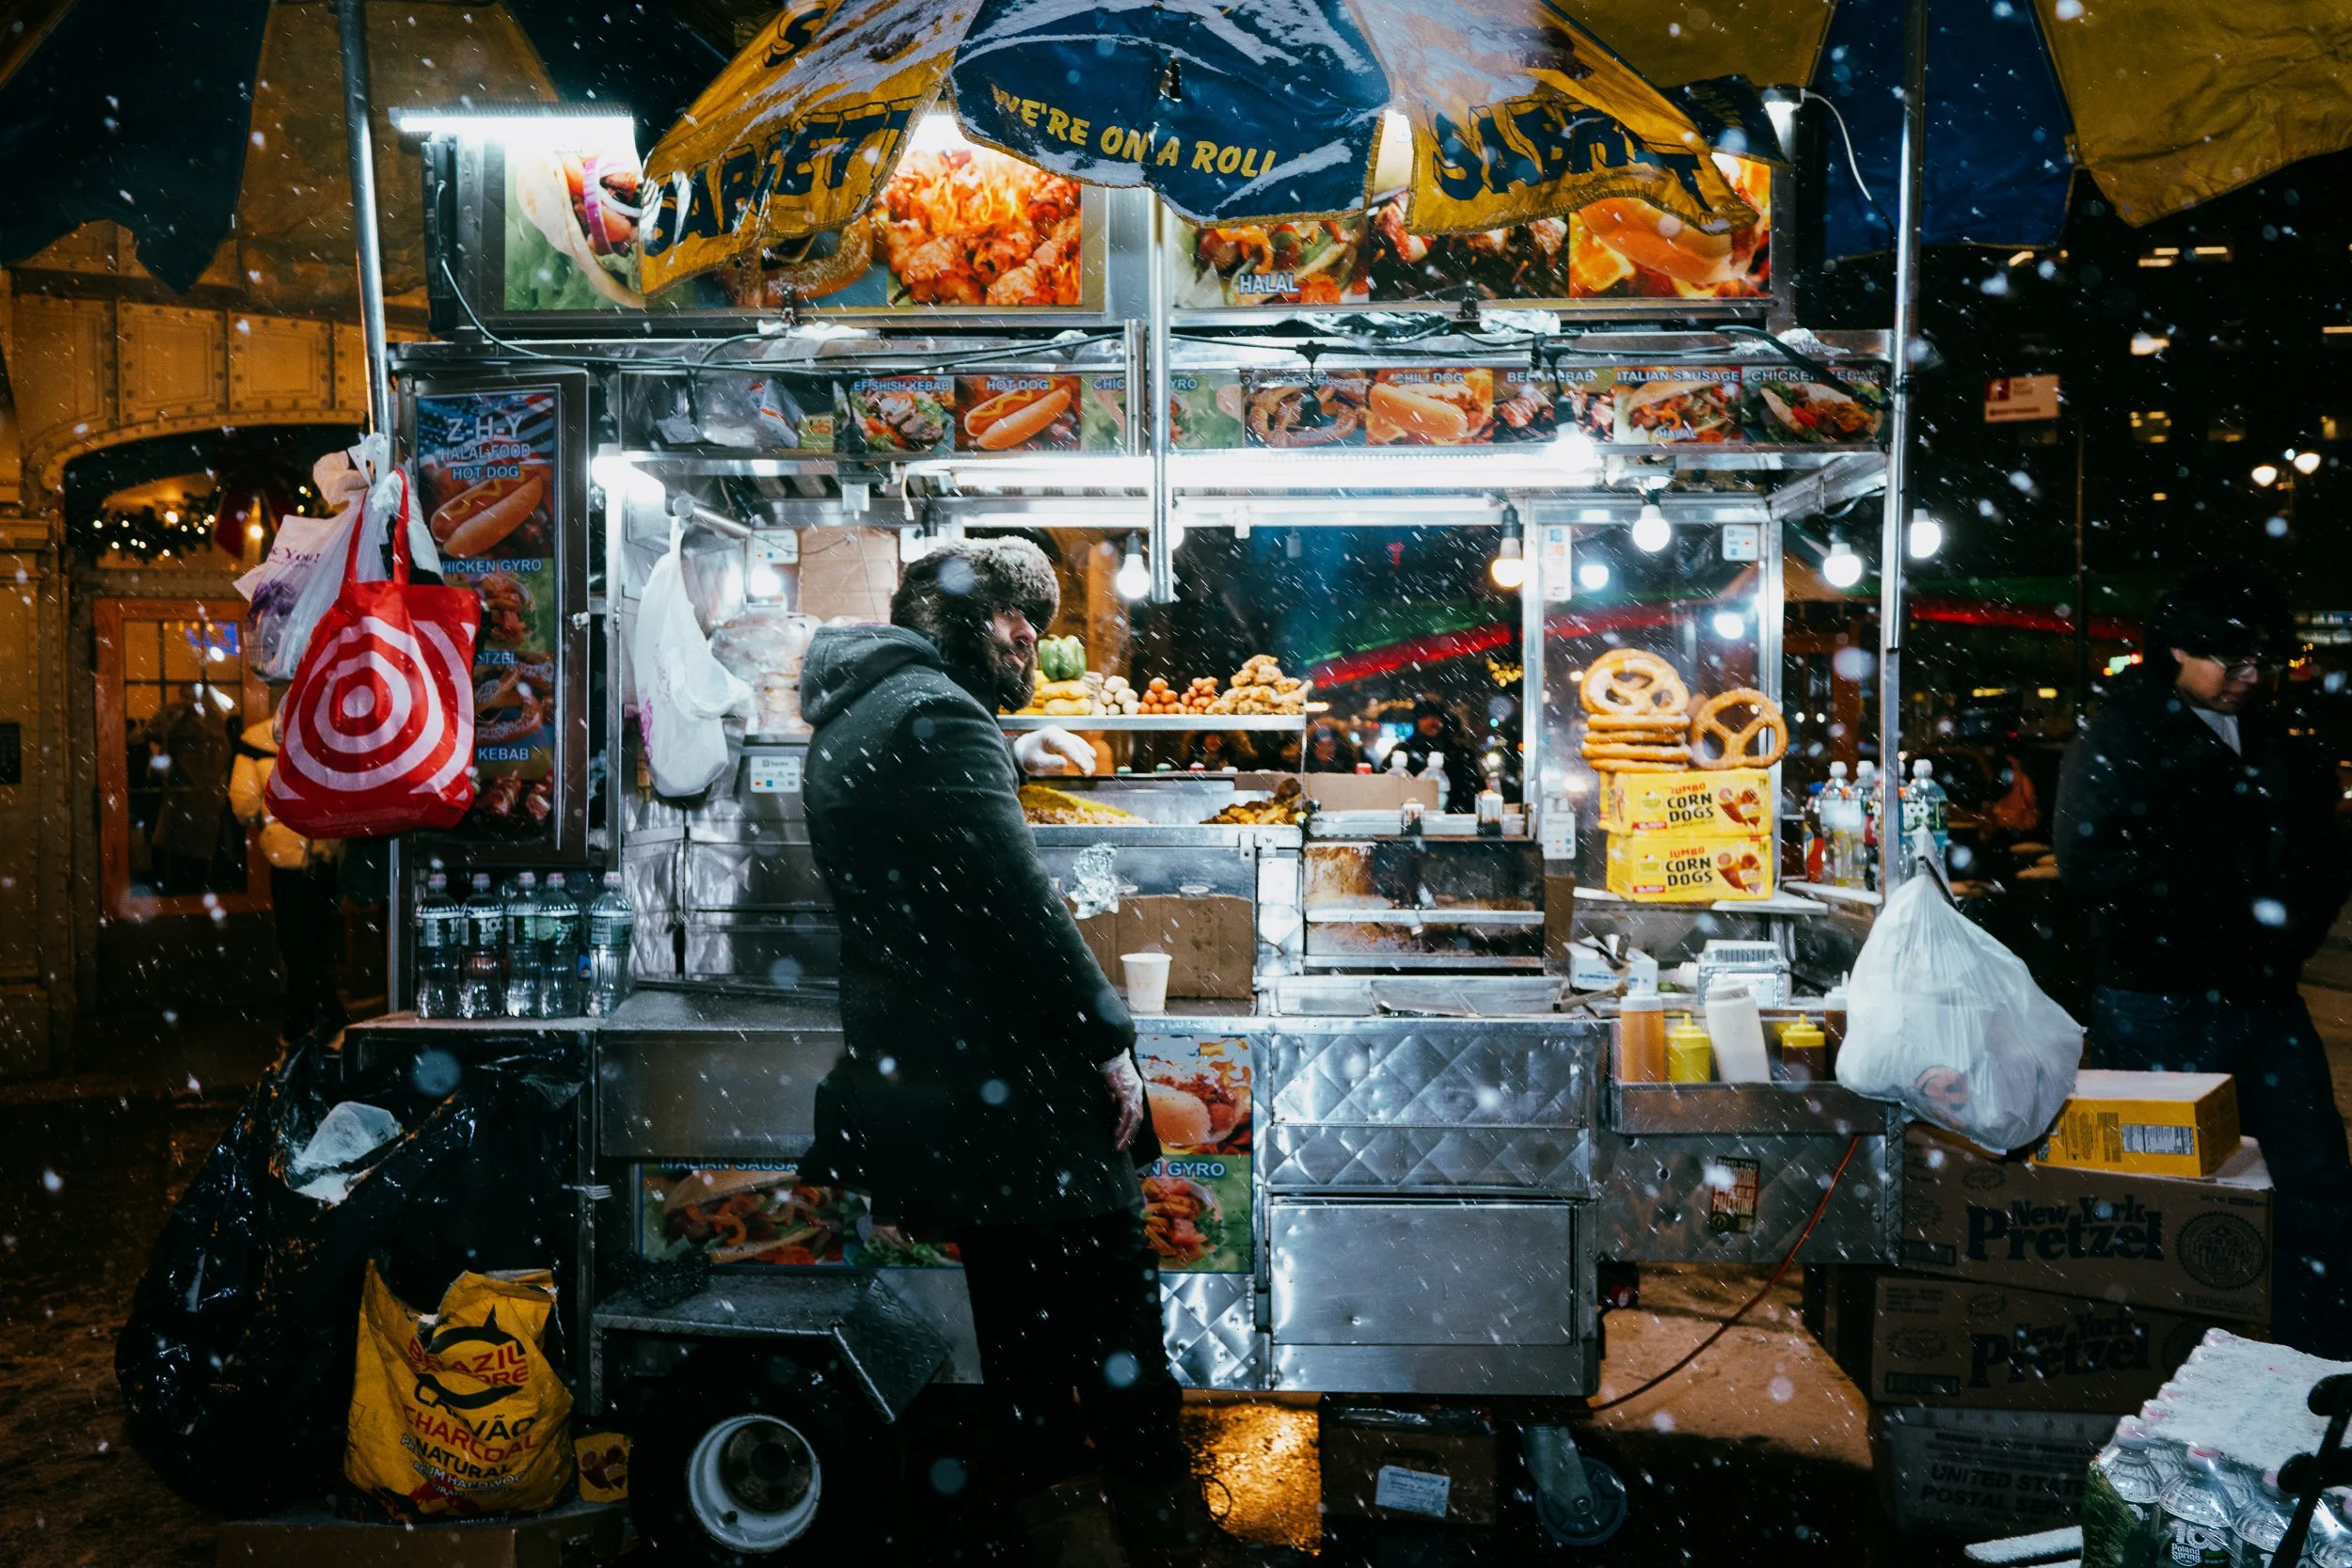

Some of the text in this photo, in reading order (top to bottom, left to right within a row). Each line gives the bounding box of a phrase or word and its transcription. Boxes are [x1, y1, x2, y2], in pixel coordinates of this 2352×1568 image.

[991, 83, 1278, 179] WE'RE ON A ROLL
[1239, 272, 1299, 293] HALAL
[1092, 378, 1198, 389] CHIC YRO
[1434, 372, 1465, 384] DOG
[1616, 370, 1740, 382] ITALIAN SAUSAGE
[1751, 371, 1814, 382] CHICKE
[871, 379, 906, 391] SHISH
[909, 379, 950, 391] KEBAB
[985, 378, 1050, 391] HOT DOG
[446, 414, 524, 442] Z-H-Y
[439, 443, 531, 460] HALAL FOOD
[452, 466, 519, 480] HOT DOG
[442, 558, 543, 573] HICKEN GYRO
[478, 748, 530, 761] KEBAB
[1671, 782, 1707, 795] JUMBO
[1667, 792, 1713, 810] CORN
[1669, 806, 1714, 823] DOGS
[1670, 846, 1705, 859] JUMBO
[1665, 857, 1711, 874] CORN
[1667, 870, 1713, 886] DOGS
[735, 1157, 799, 1171] SAUSA
[1167, 1162, 1226, 1177] GYRO
[2011, 1195, 2147, 1227] New York
[1966, 1205, 2165, 1262] Pretzel
[1968, 1323, 2152, 1389] Pretzel
[403, 1404, 538, 1464] CHARCOAL
[415, 1436, 512, 1479] NATURAL
[1931, 1464, 2086, 1497] UNITED STATE
[1921, 1484, 2082, 1518] POSTAL SERVI
[2171, 1543, 2201, 1556] Poland
[2171, 1551, 2201, 1564] Spring
